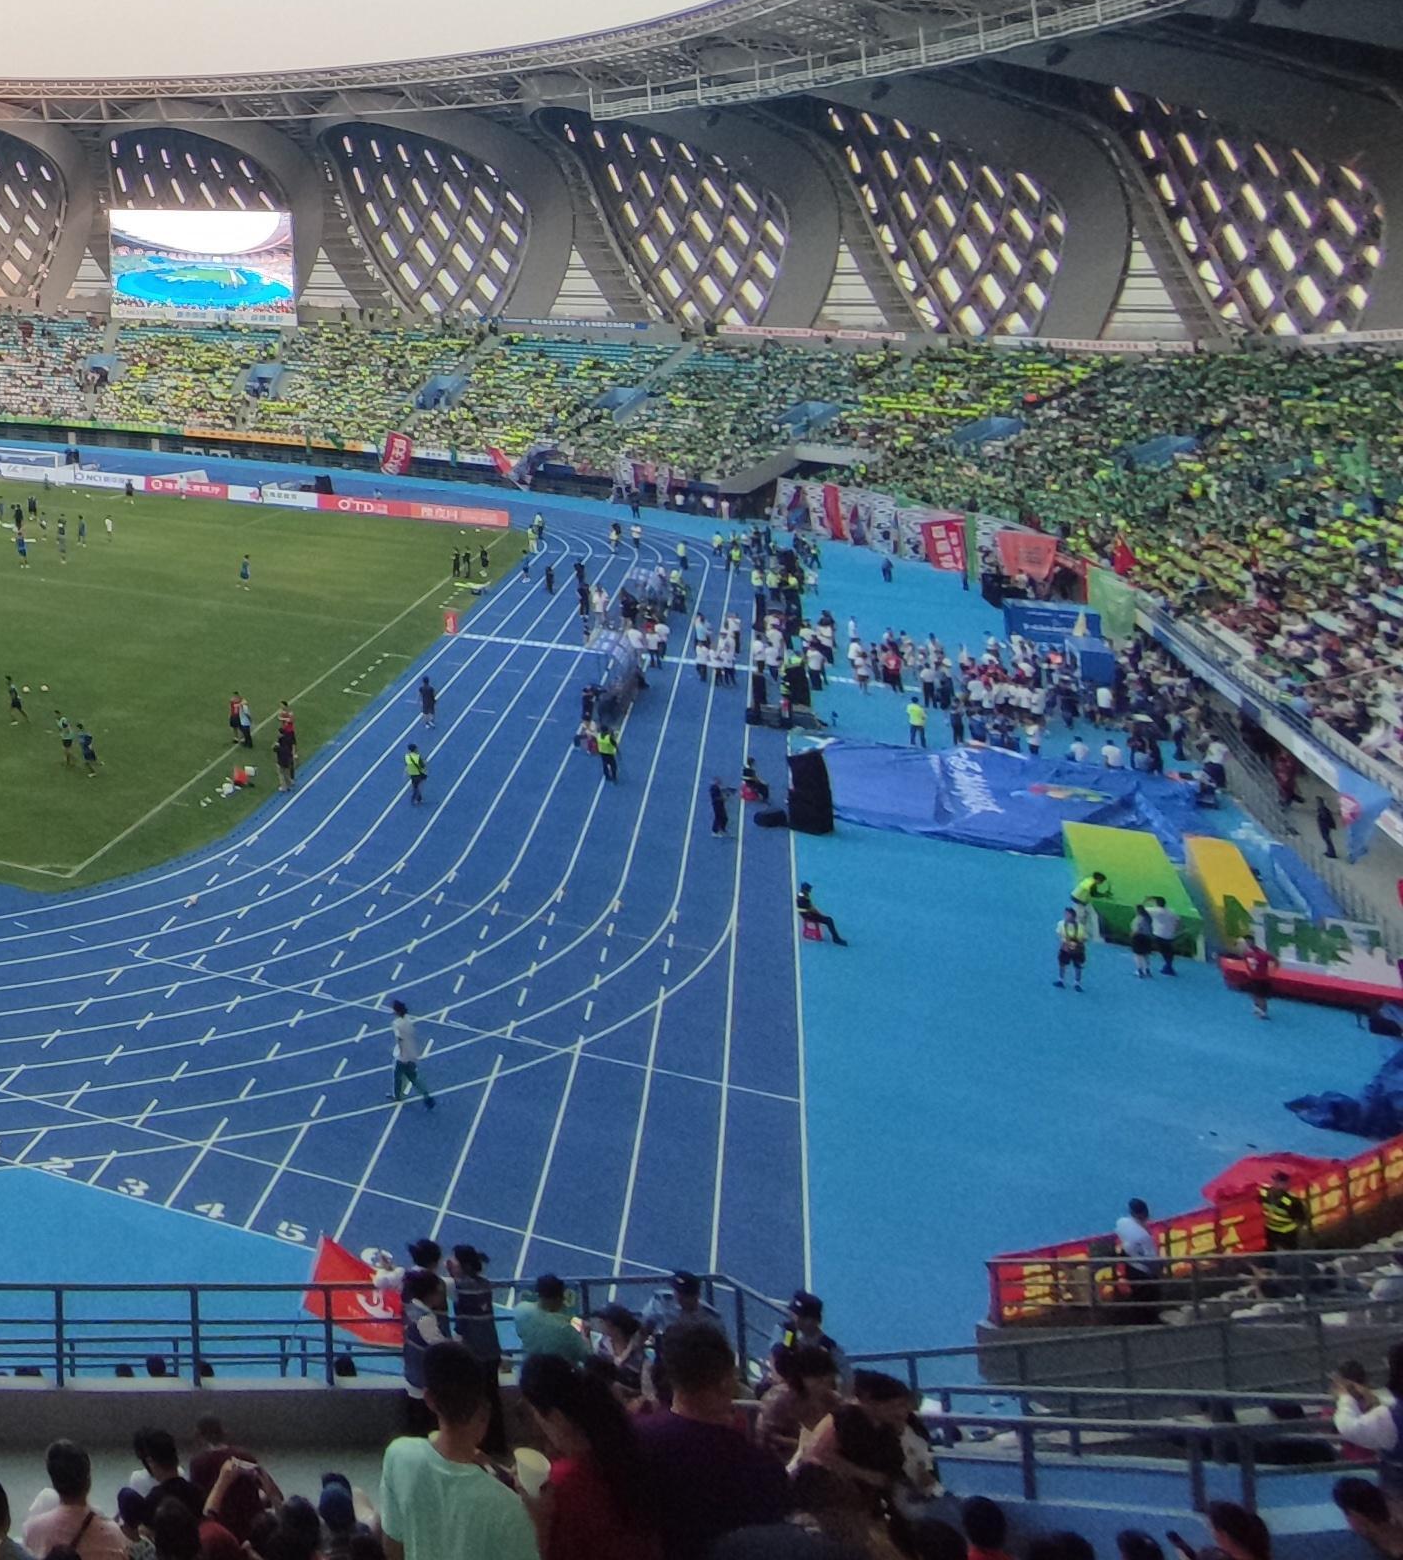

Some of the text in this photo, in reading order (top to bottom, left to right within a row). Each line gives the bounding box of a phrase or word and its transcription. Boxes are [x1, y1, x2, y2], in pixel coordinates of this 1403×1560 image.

[41, 1156, 75, 1176] 2
[116, 1177, 151, 1198] 3
[194, 1201, 227, 1220] 4
[274, 1220, 309, 1243] 5
